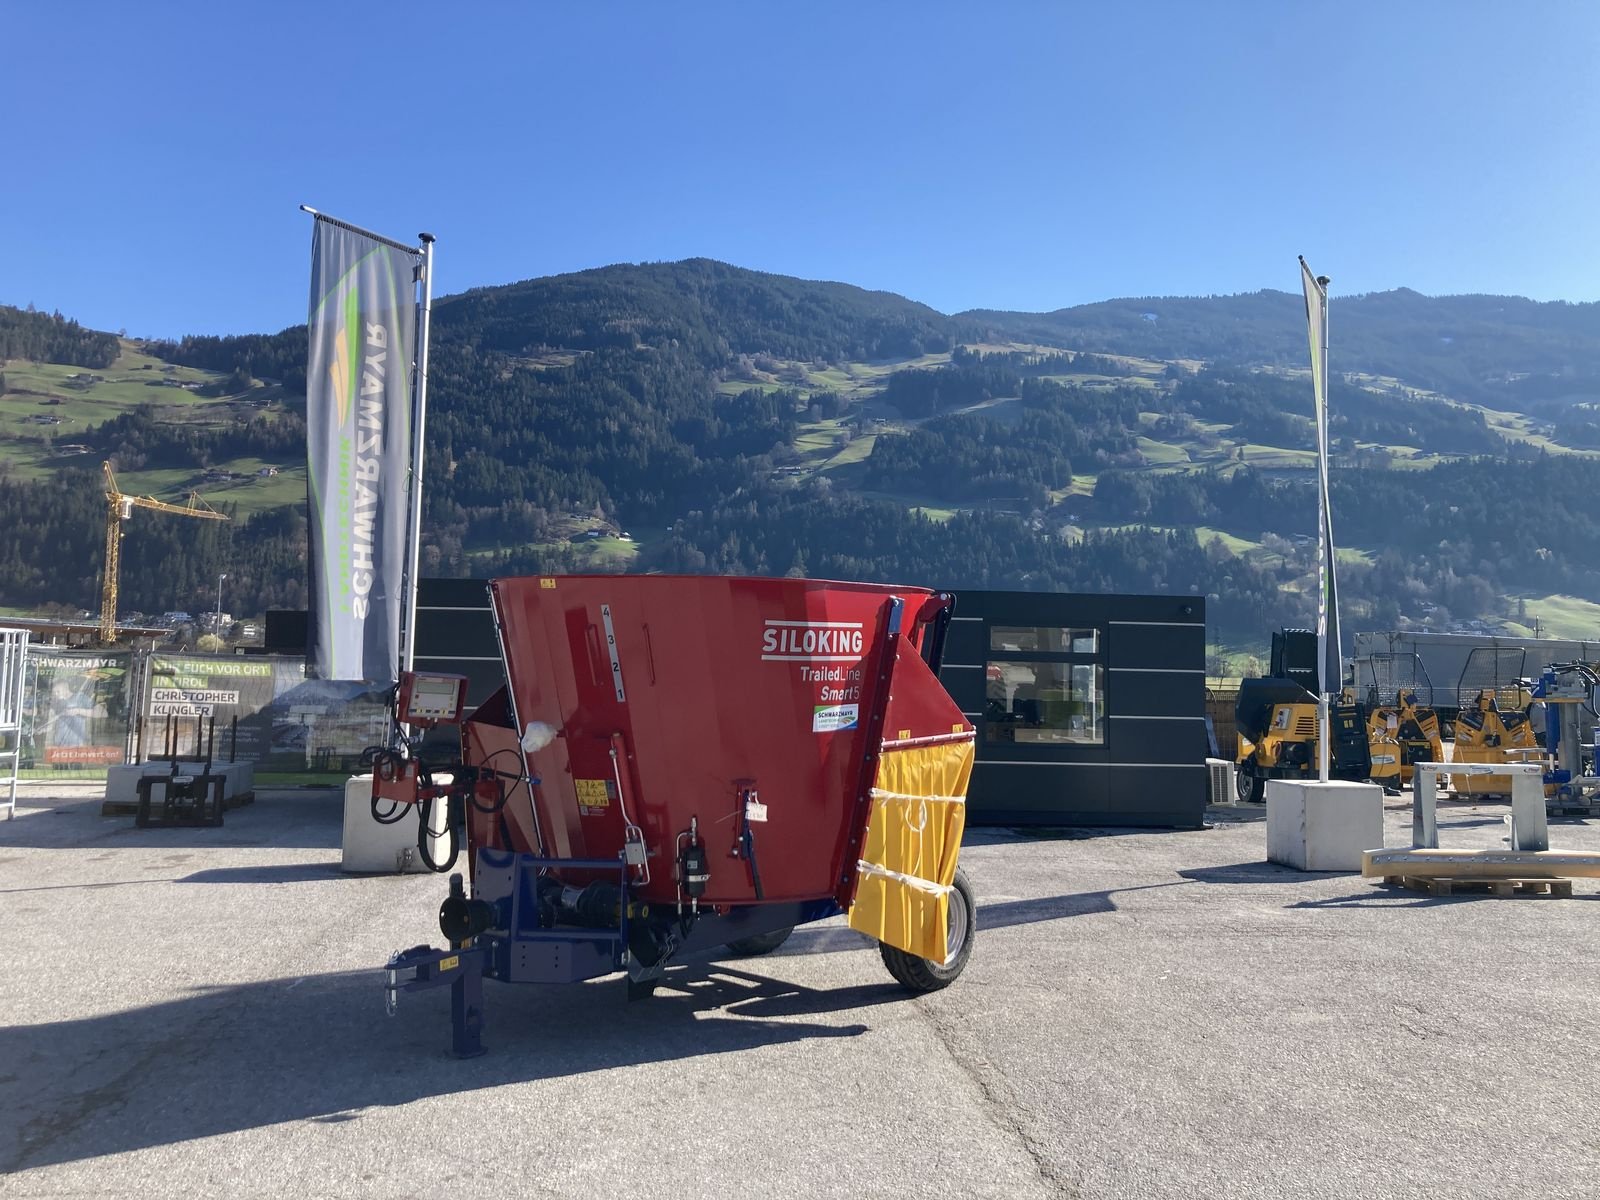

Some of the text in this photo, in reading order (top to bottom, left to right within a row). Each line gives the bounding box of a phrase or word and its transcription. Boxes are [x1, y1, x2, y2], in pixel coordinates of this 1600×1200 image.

[603, 607, 610, 617] 4
[608, 634, 615, 645] 3
[762, 628, 863, 653] SILOKING
[216, 664, 241, 675] VOR
[244, 665, 268, 675] ORT
[613, 662, 620, 673] 2
[800, 666, 861, 682] TrailedLine
[156, 676, 169, 686] IN
[155, 691, 235, 702] CHRISTOPHER
[618, 689, 623, 699] 1
[154, 704, 210, 716] KLINGLER
